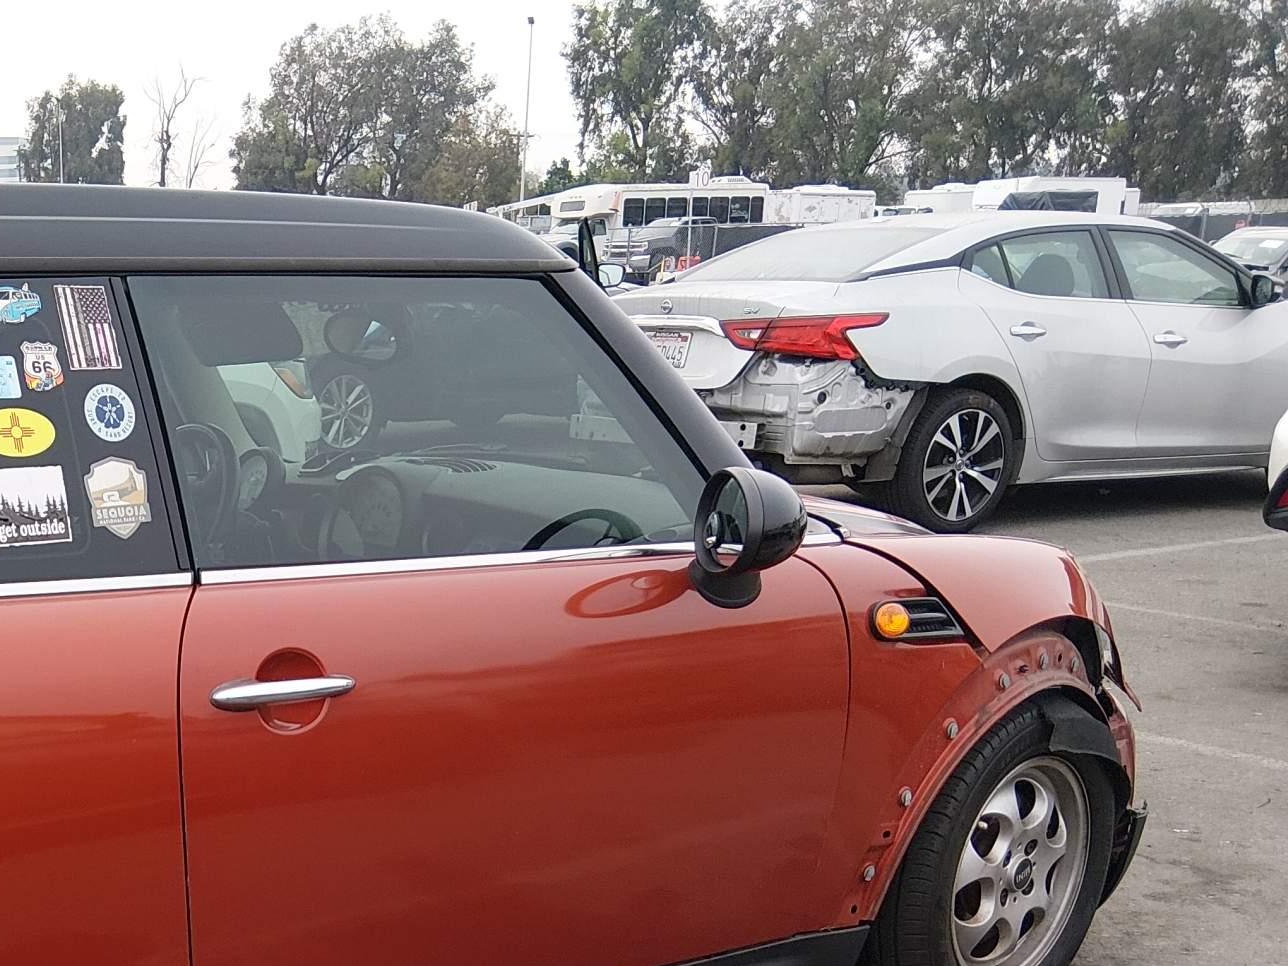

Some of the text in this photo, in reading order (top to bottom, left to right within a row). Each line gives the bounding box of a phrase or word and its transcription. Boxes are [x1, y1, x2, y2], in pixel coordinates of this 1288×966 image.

[695, 171, 710, 187] 10
[743, 307, 761, 315] SV
[32, 361, 55, 374] 66
[96, 505, 147, 520] SEQUOIA
[19, 518, 66, 537] outside
